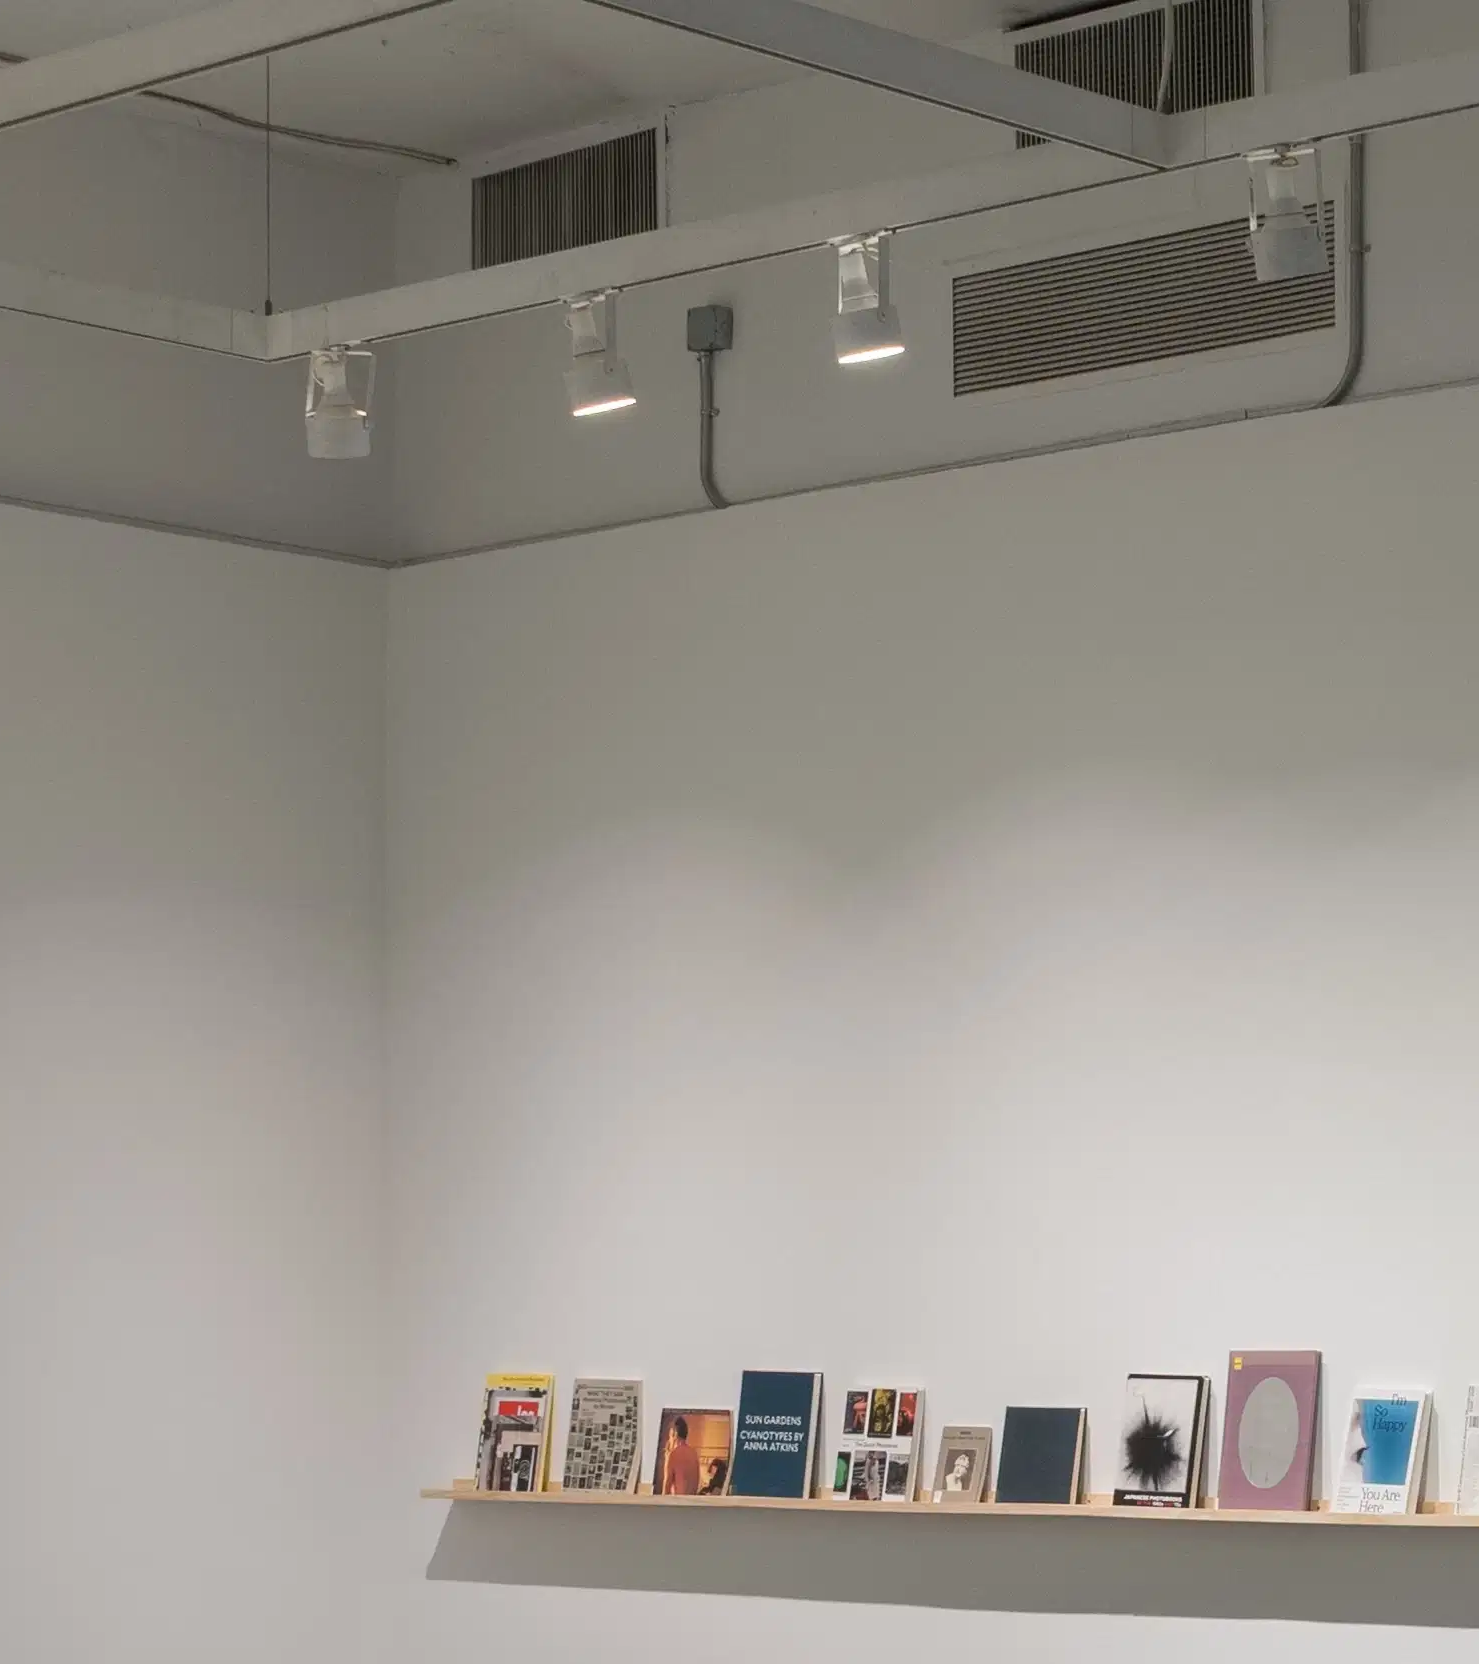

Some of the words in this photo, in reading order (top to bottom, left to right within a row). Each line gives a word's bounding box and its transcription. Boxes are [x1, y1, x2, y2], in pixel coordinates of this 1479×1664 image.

[1391, 1393, 1407, 1406] I'm
[1374, 1405, 1388, 1417] So
[746, 1415, 763, 1425] SUN
[764, 1416, 802, 1426] GARDENS
[1373, 1417, 1407, 1432] Happy
[740, 1430, 792, 1441] CYANOTYPES
[794, 1432, 804, 1441] BY
[744, 1443, 768, 1451] ANNA
[770, 1443, 799, 1452] ATKINS
[1361, 1487, 1381, 1501] You
[1383, 1489, 1401, 1501] Are
[1359, 1500, 1384, 1513] Here
